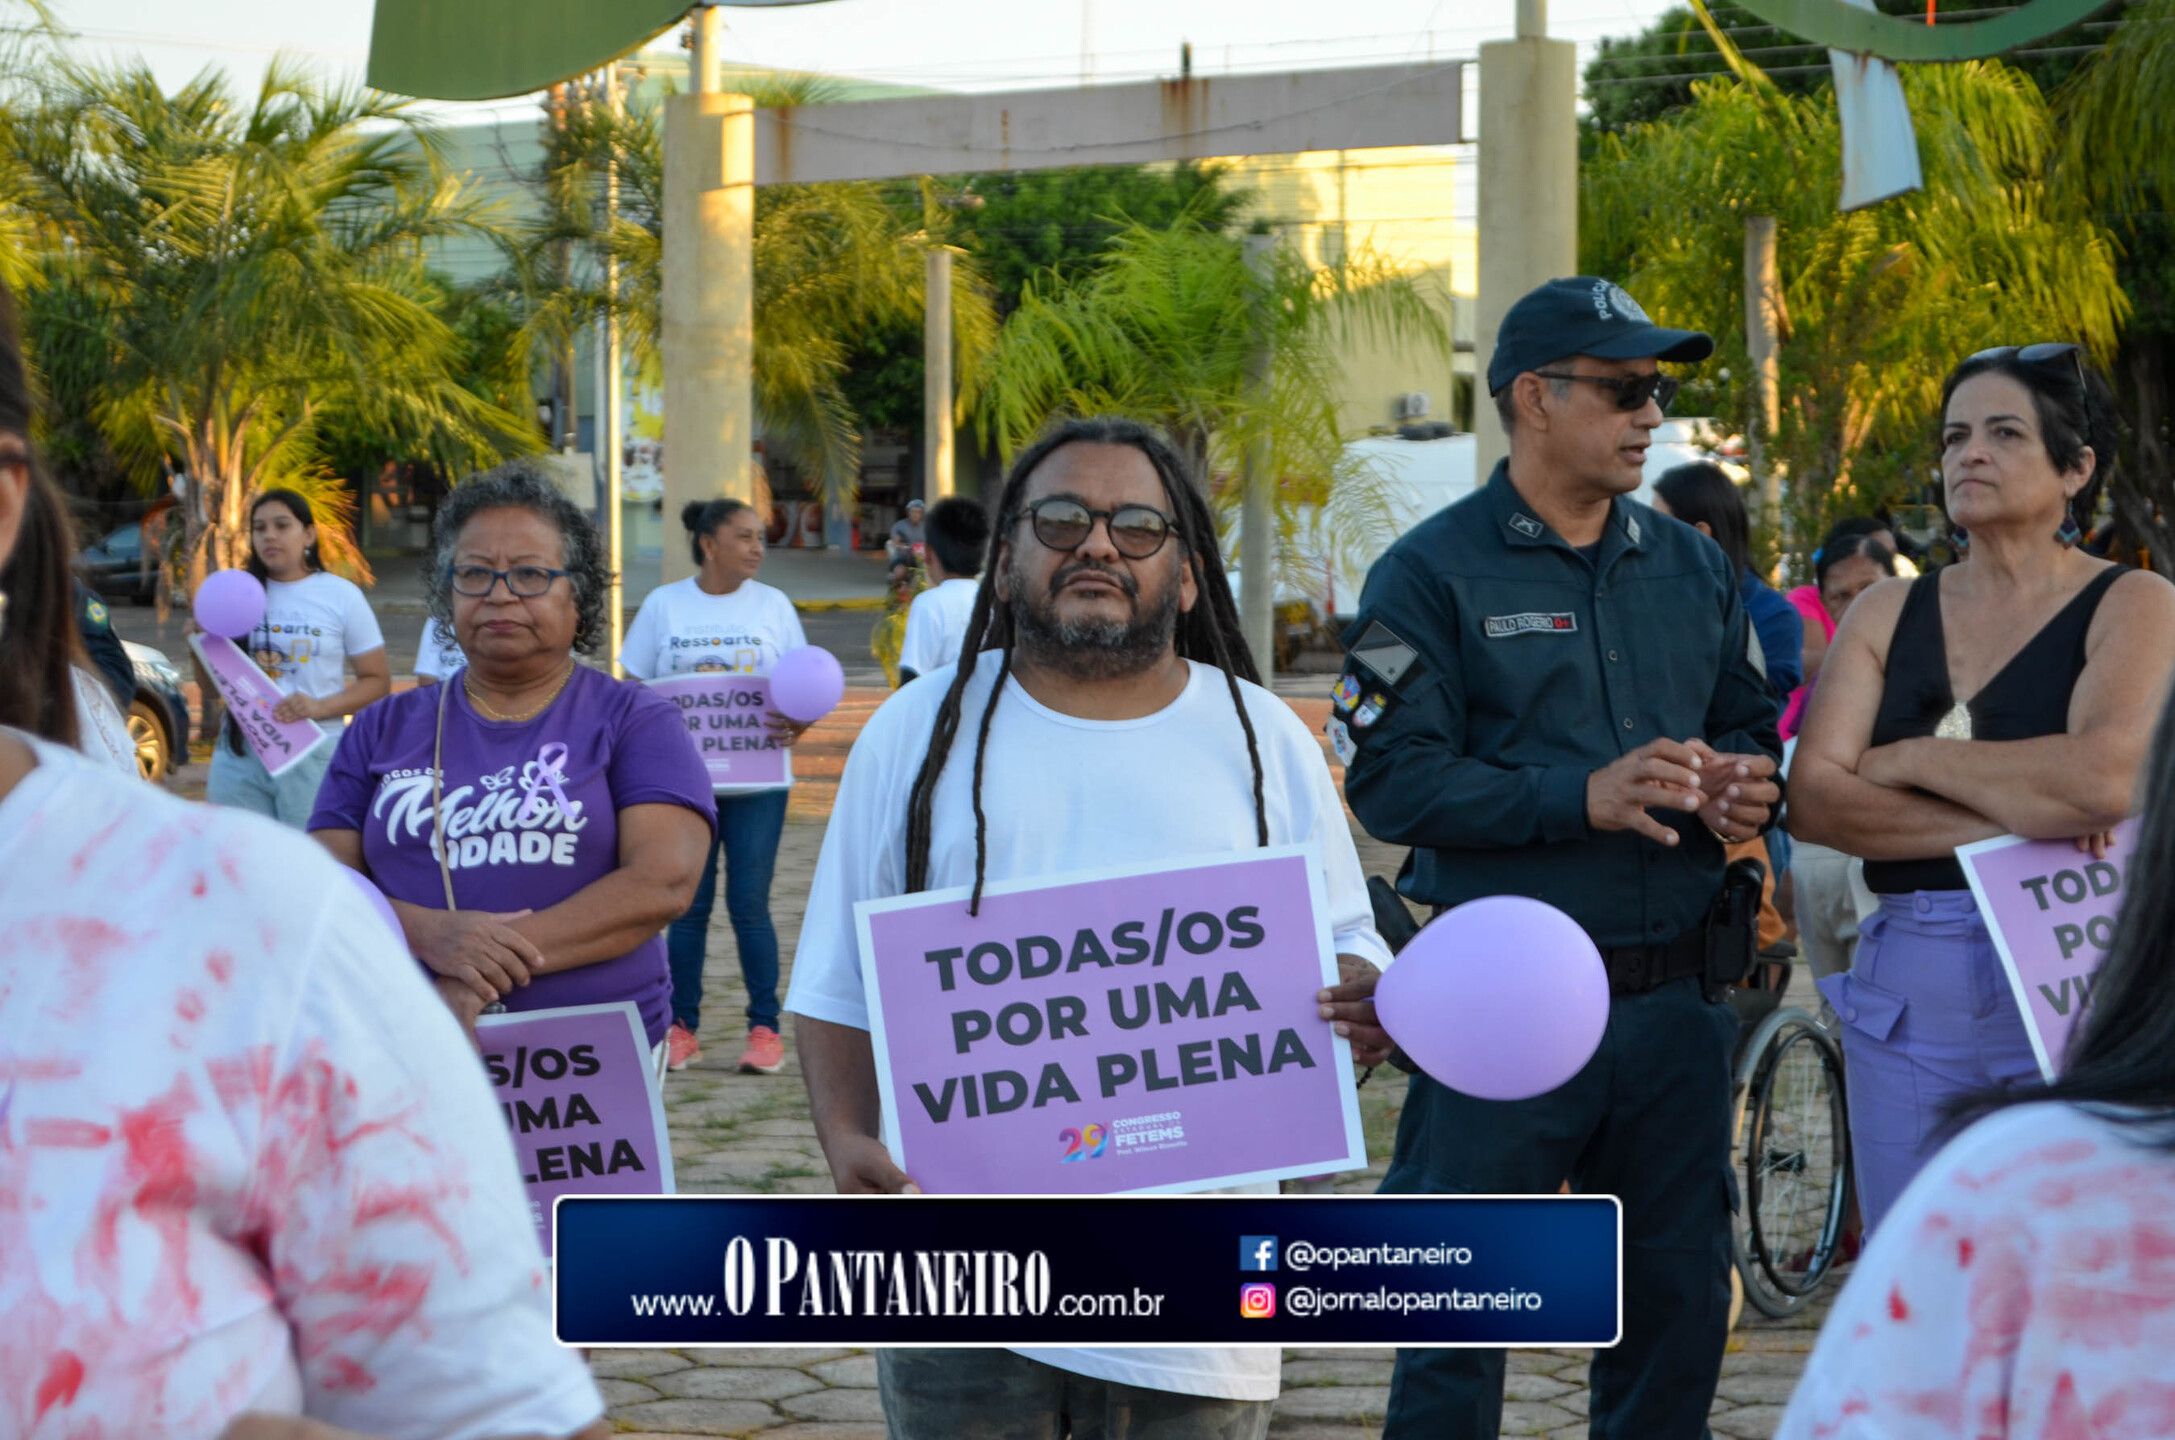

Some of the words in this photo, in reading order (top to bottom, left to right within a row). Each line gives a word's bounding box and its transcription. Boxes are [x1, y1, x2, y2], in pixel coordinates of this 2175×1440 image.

[670, 635, 762, 650] Ressoarte
[709, 713, 761, 730] UMA
[702, 735, 778, 752] PLENA
[924, 905, 1266, 992] TODAS/OS
[2052, 914, 2118, 960] PO
[950, 995, 1090, 1054] POR
[1107, 970, 1262, 1031] UMA
[912, 1061, 1082, 1124] VIDA
[1096, 1028, 1317, 1099] PLENA
[1112, 1110, 1182, 1129] CONGRESSO
[1115, 1126, 1185, 1147] FETEMS
[523, 1138, 646, 1184] ENA
